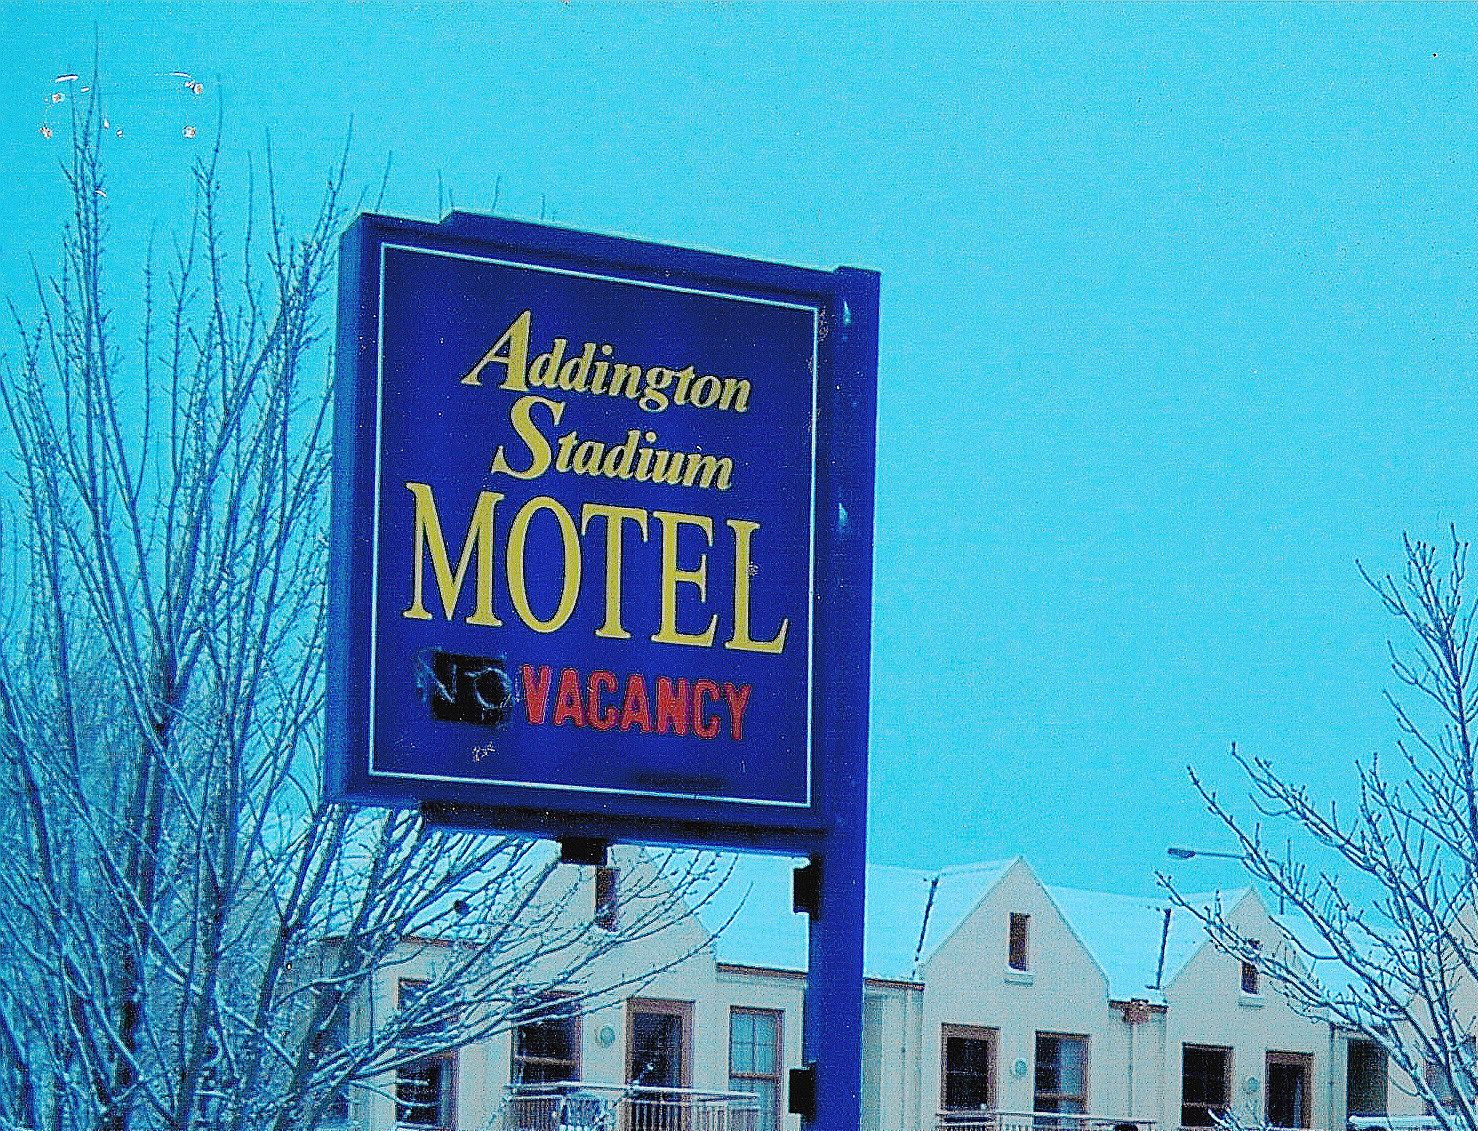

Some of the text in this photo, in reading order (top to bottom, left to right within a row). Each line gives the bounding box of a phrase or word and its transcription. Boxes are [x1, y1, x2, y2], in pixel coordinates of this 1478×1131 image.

[462, 309, 751, 414] Addington
[491, 395, 734, 490] Stadium
[402, 482, 790, 654] MOTEL
[521, 664, 752, 740] VACANCY
